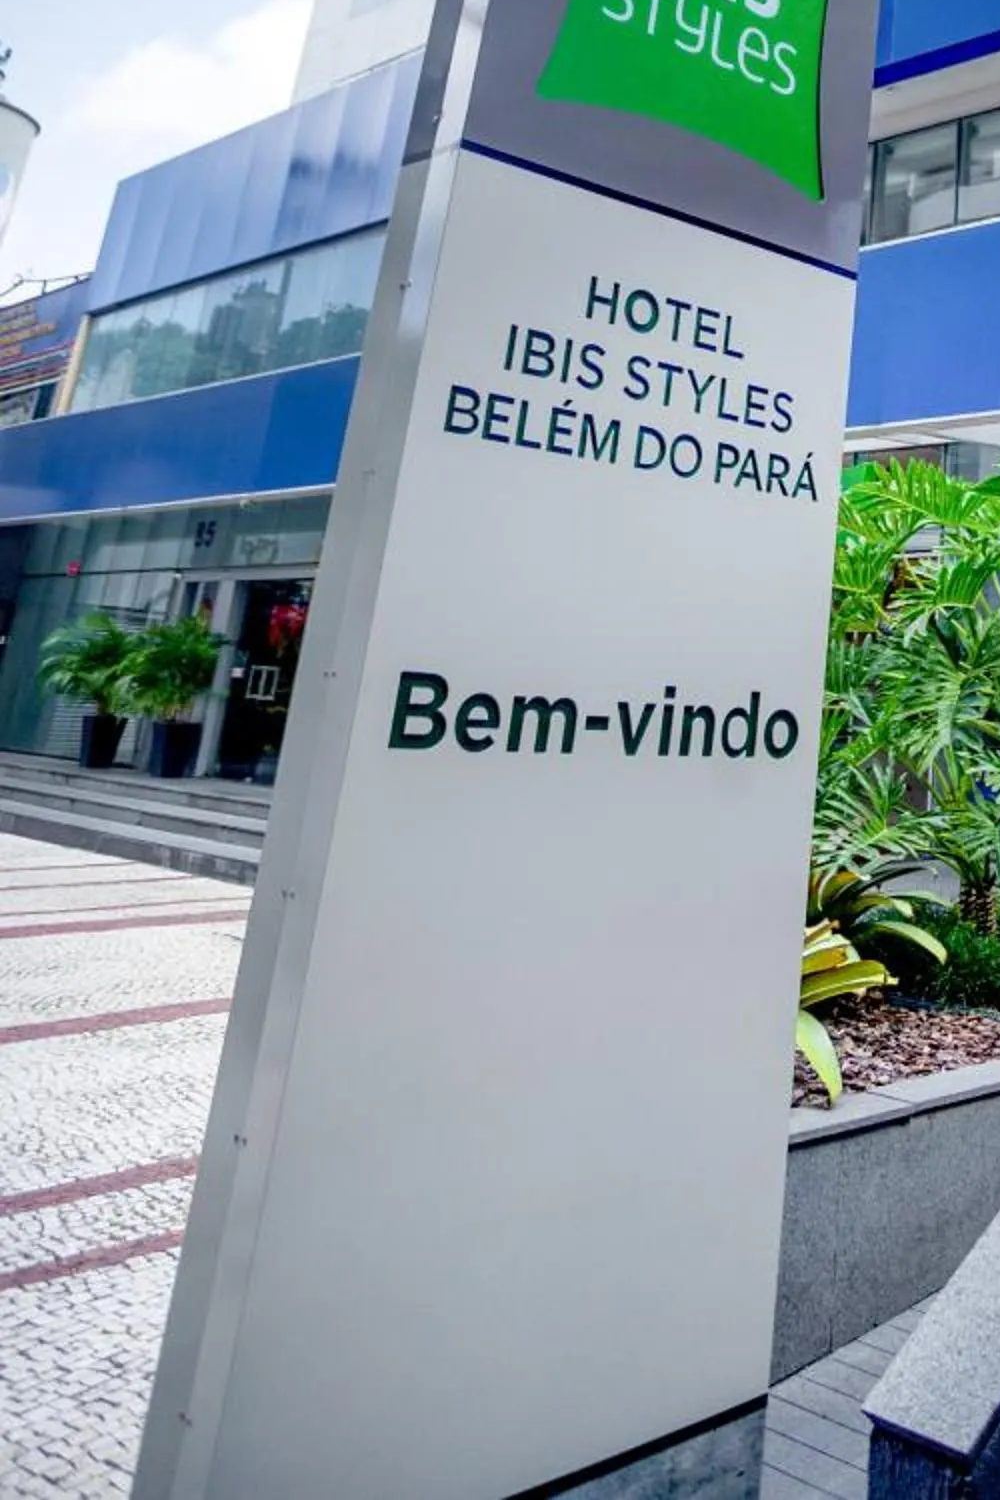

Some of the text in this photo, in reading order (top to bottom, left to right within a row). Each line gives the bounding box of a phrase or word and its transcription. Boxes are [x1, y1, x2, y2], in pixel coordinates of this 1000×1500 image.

[585, 276, 744, 359] HOTEL
[503, 324, 794, 433] IBIS STYLES
[443, 384, 819, 502] BELÉM DO PARÁ
[387, 671, 799, 759] Bem-vindo
